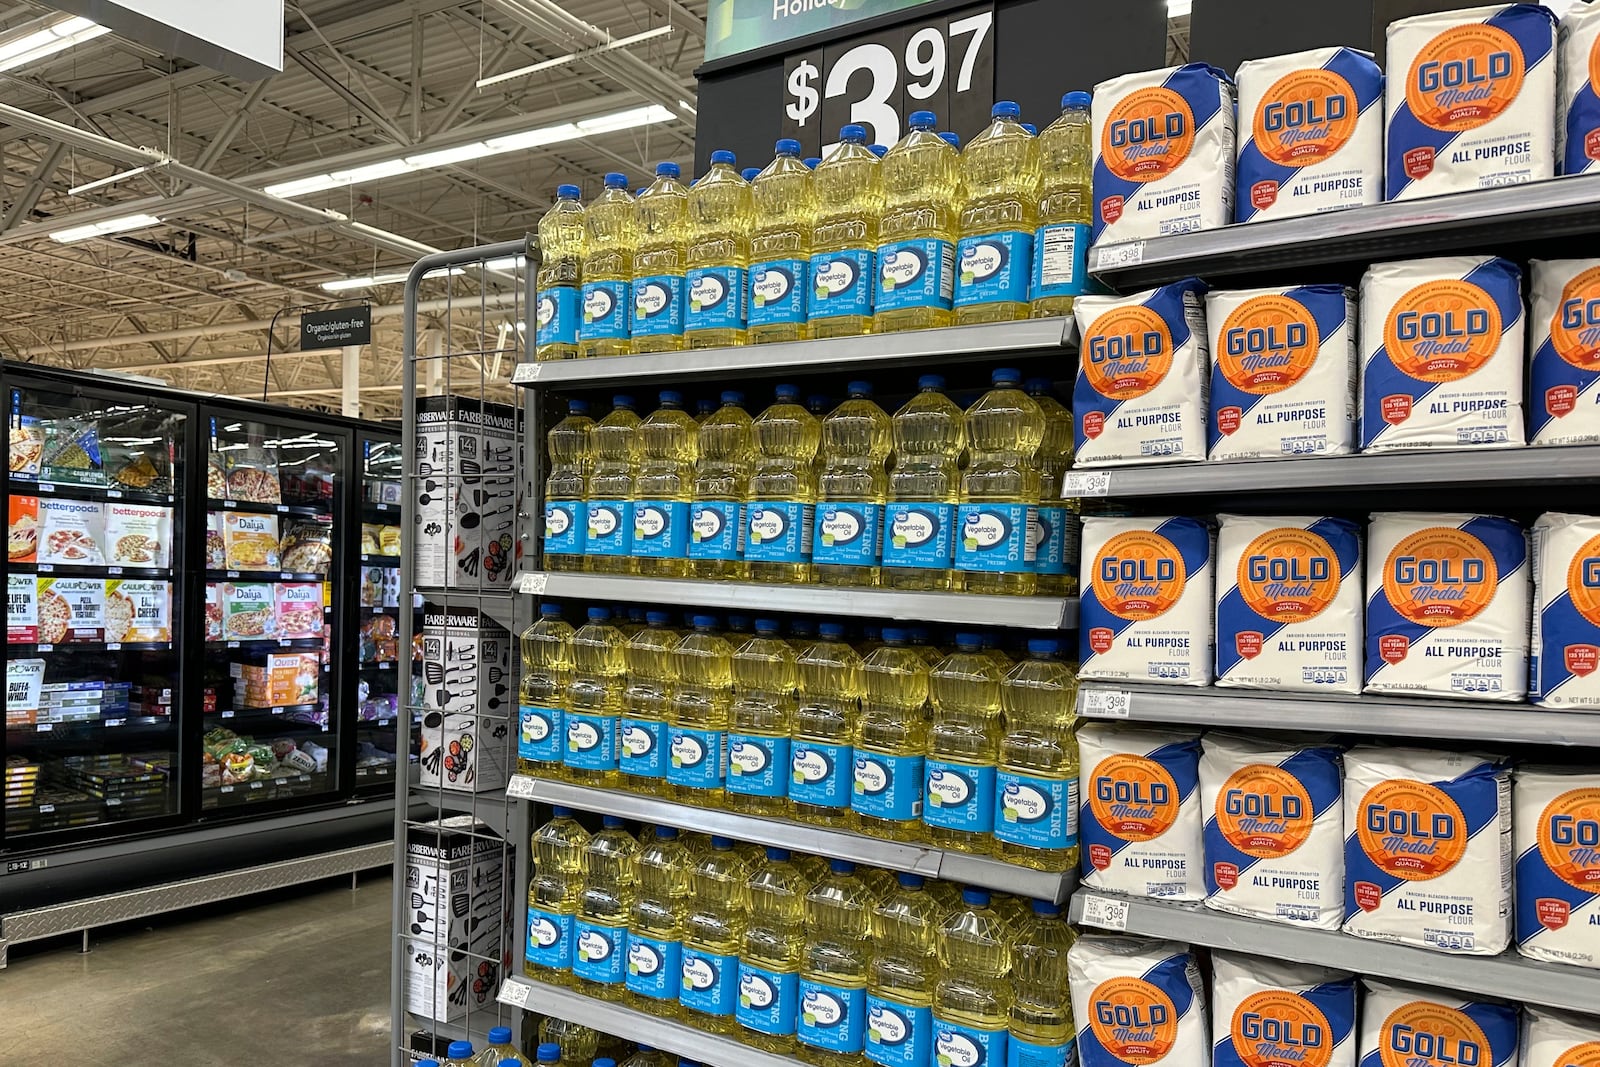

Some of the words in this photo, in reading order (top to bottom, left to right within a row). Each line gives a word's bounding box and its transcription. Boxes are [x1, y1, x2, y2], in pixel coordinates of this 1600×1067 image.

[1418, 52, 1512, 92] GOLD
[1435, 82, 1491, 109] Medal
[1264, 94, 1346, 131] GOLD
[1450, 110, 1481, 120] QUALITY
[1110, 112, 1185, 148] GOLD
[1279, 124, 1329, 147] Medal
[1123, 140, 1170, 162] Medal
[1292, 148, 1319, 156] QUALITY
[1452, 152, 1471, 163] ALL
[1475, 142, 1530, 159] PURPOSE
[1505, 154, 1531, 165] FLOUR
[1134, 164, 1160, 172] QUALITY
[1293, 186, 1310, 196] ALL
[1313, 178, 1362, 193] PURPOSE
[1340, 189, 1363, 198] FLOUR
[1137, 197, 1153, 211] ALL
[1156, 191, 1200, 208] PURPOSE
[1180, 202, 1200, 212] FLOUR
[924, 241, 936, 295] BAKING
[964, 257, 993, 267] Vegetable
[819, 272, 846, 282] Vegetable
[856, 253, 867, 304] BAKING
[693, 288, 716, 296] Vegetable
[727, 270, 736, 318] BAKING
[756, 282, 781, 291] Vegetable
[791, 262, 802, 312] BAKING
[307, 319, 364, 334] Organic/gluten-free
[1396, 308, 1490, 341] GOLD
[1227, 322, 1308, 356] GOLD
[1089, 331, 1163, 364] GOLD
[1413, 337, 1469, 359] Medal
[1103, 359, 1148, 379] Medal
[1241, 350, 1291, 372] Medal
[1428, 362, 1459, 370] QUALITY
[1430, 403, 1449, 414] ALL
[1453, 399, 1507, 412] PURPOSE
[1483, 409, 1507, 419] FLOUR
[459, 409, 514, 429] FARBERWARE
[1117, 417, 1133, 428] ALL
[1136, 412, 1181, 427] PURPOSE
[1257, 413, 1273, 424] ALL
[1277, 408, 1325, 422] PURPOSE
[1303, 420, 1326, 429] FLOUR
[40, 501, 99, 513] bettergoods
[112, 507, 167, 518] bettergoods
[239, 517, 265, 531] Daiya
[862, 506, 873, 555] BAKING
[936, 507, 947, 558] BAKING
[1008, 507, 1021, 560] BAKING
[1101, 557, 1175, 582] GOLD
[1248, 554, 1329, 582] GOLD
[1395, 556, 1484, 584] GOLD
[236, 588, 262, 600] Daiya
[287, 588, 311, 600] Daiya
[1114, 583, 1160, 599] Medal
[1264, 582, 1313, 600] Medal
[1411, 586, 1467, 604] Medal
[138, 604, 160, 618] CHEESY
[425, 614, 477, 627] FARBERWARE
[1127, 639, 1142, 648] ALL
[1146, 639, 1190, 648] PURPOSE
[1278, 641, 1295, 651] ALL
[1299, 641, 1346, 651] PURPOSE
[1425, 646, 1445, 657] ALL
[1448, 646, 1502, 657] PURPOSE
[1324, 652, 1346, 660] FLOUR
[1477, 659, 1502, 667] FLOUR
[602, 719, 610, 761] BAKING
[932, 783, 960, 792] Vegetable
[1097, 777, 1169, 805] GOLD
[1006, 796, 1037, 807] Vegetable
[1226, 789, 1303, 819] GOLD
[1050, 784, 1062, 837] BAKING
[1110, 805, 1155, 820] Medal
[1238, 819, 1287, 834] Medal
[1367, 804, 1454, 840] GOLD
[1382, 837, 1437, 855] Medal
[1124, 859, 1140, 868] ALL
[1142, 859, 1186, 869] PURPOSE
[1253, 876, 1269, 887] ALL
[1272, 876, 1319, 890] PURPOSE
[1398, 898, 1416, 911] ALL
[1420, 901, 1473, 915] PURPOSE
[1448, 916, 1473, 925] FLOUR
[611, 931, 622, 973] BAKING
[806, 1002, 833, 1013] Vegetable
[1096, 1001, 1167, 1028] GOLD
[1113, 1027, 1155, 1042] Medal
[1242, 1012, 1322, 1047] GOLD
[940, 1042, 971, 1056] Vegetable
[1256, 1043, 1306, 1061] Medal
[1391, 1024, 1480, 1066] GOLD
